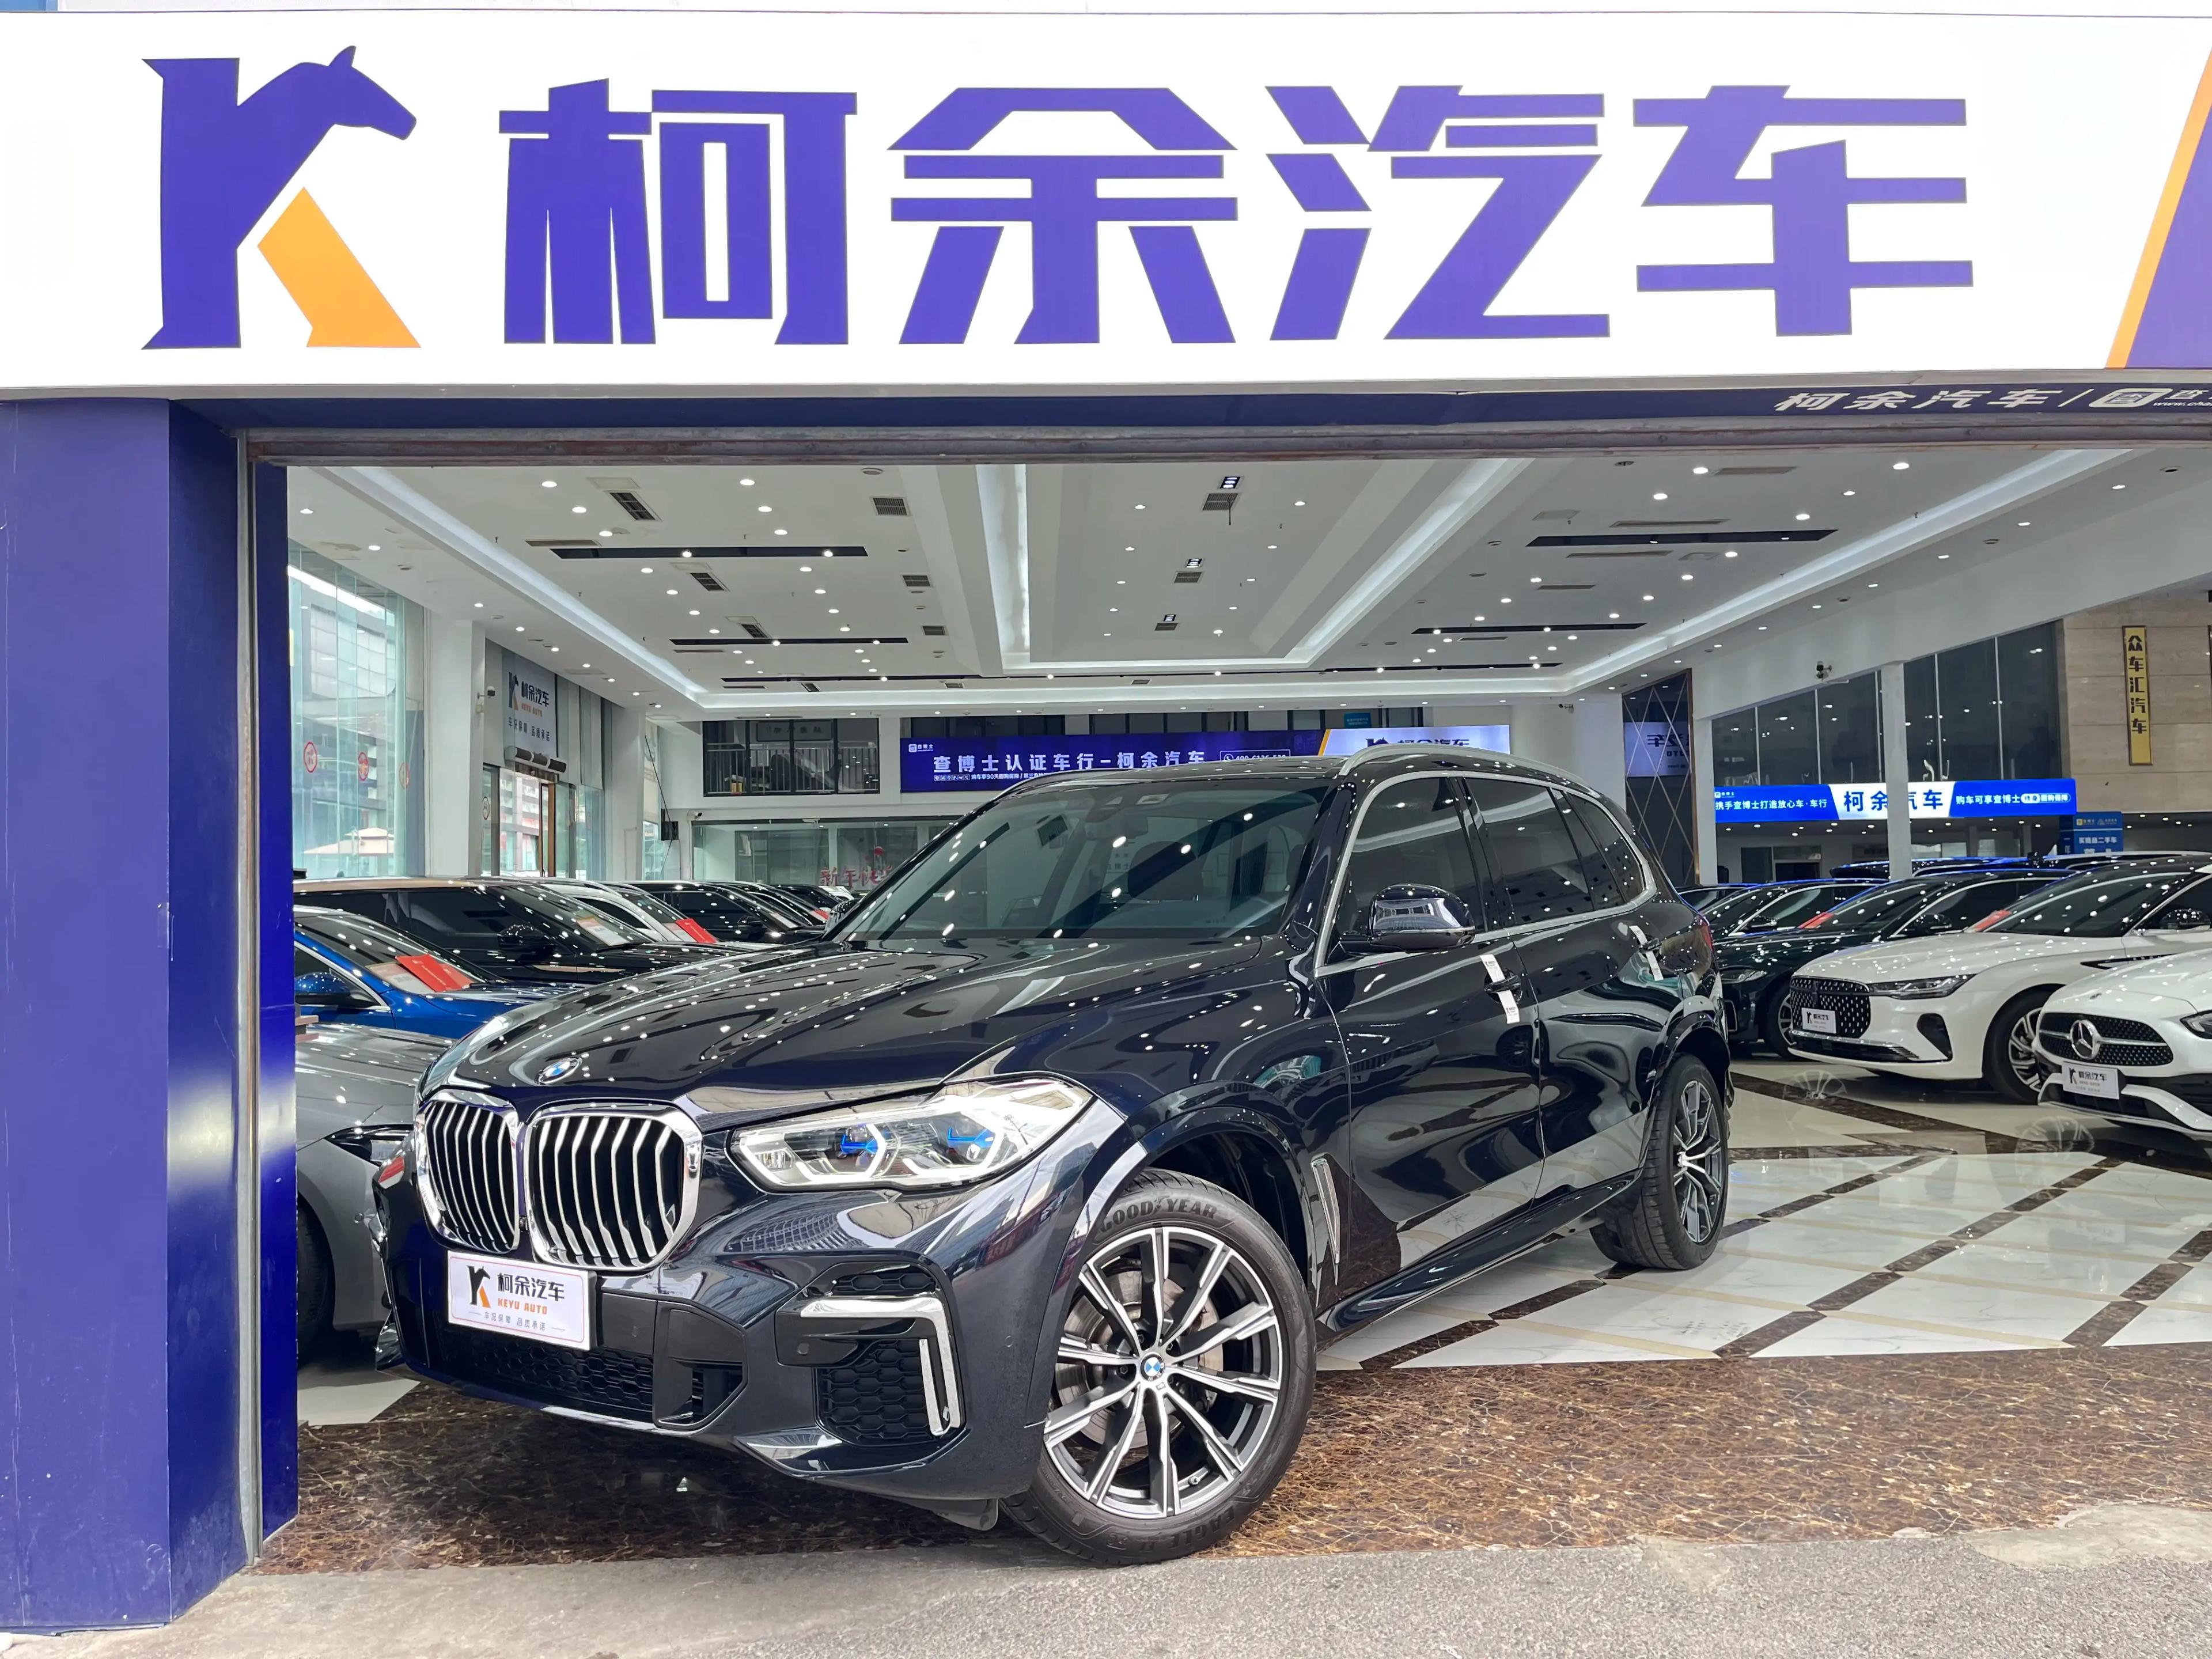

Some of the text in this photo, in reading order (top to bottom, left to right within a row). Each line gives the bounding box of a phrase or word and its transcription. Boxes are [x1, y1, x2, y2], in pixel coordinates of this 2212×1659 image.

[499, 78, 1972, 344] 柯余汽车
[1774, 389, 2063, 411] 柯余汽车
[2164, 389, 2212, 400] 查
[2128, 635, 2147, 734] 众车汇汽车
[497, 1272, 565, 1301] 柯余汽车
[498, 1298, 547, 1315] KEYU AUTO
[484, 1312, 546, 1331] 车况保障 品质承诺
